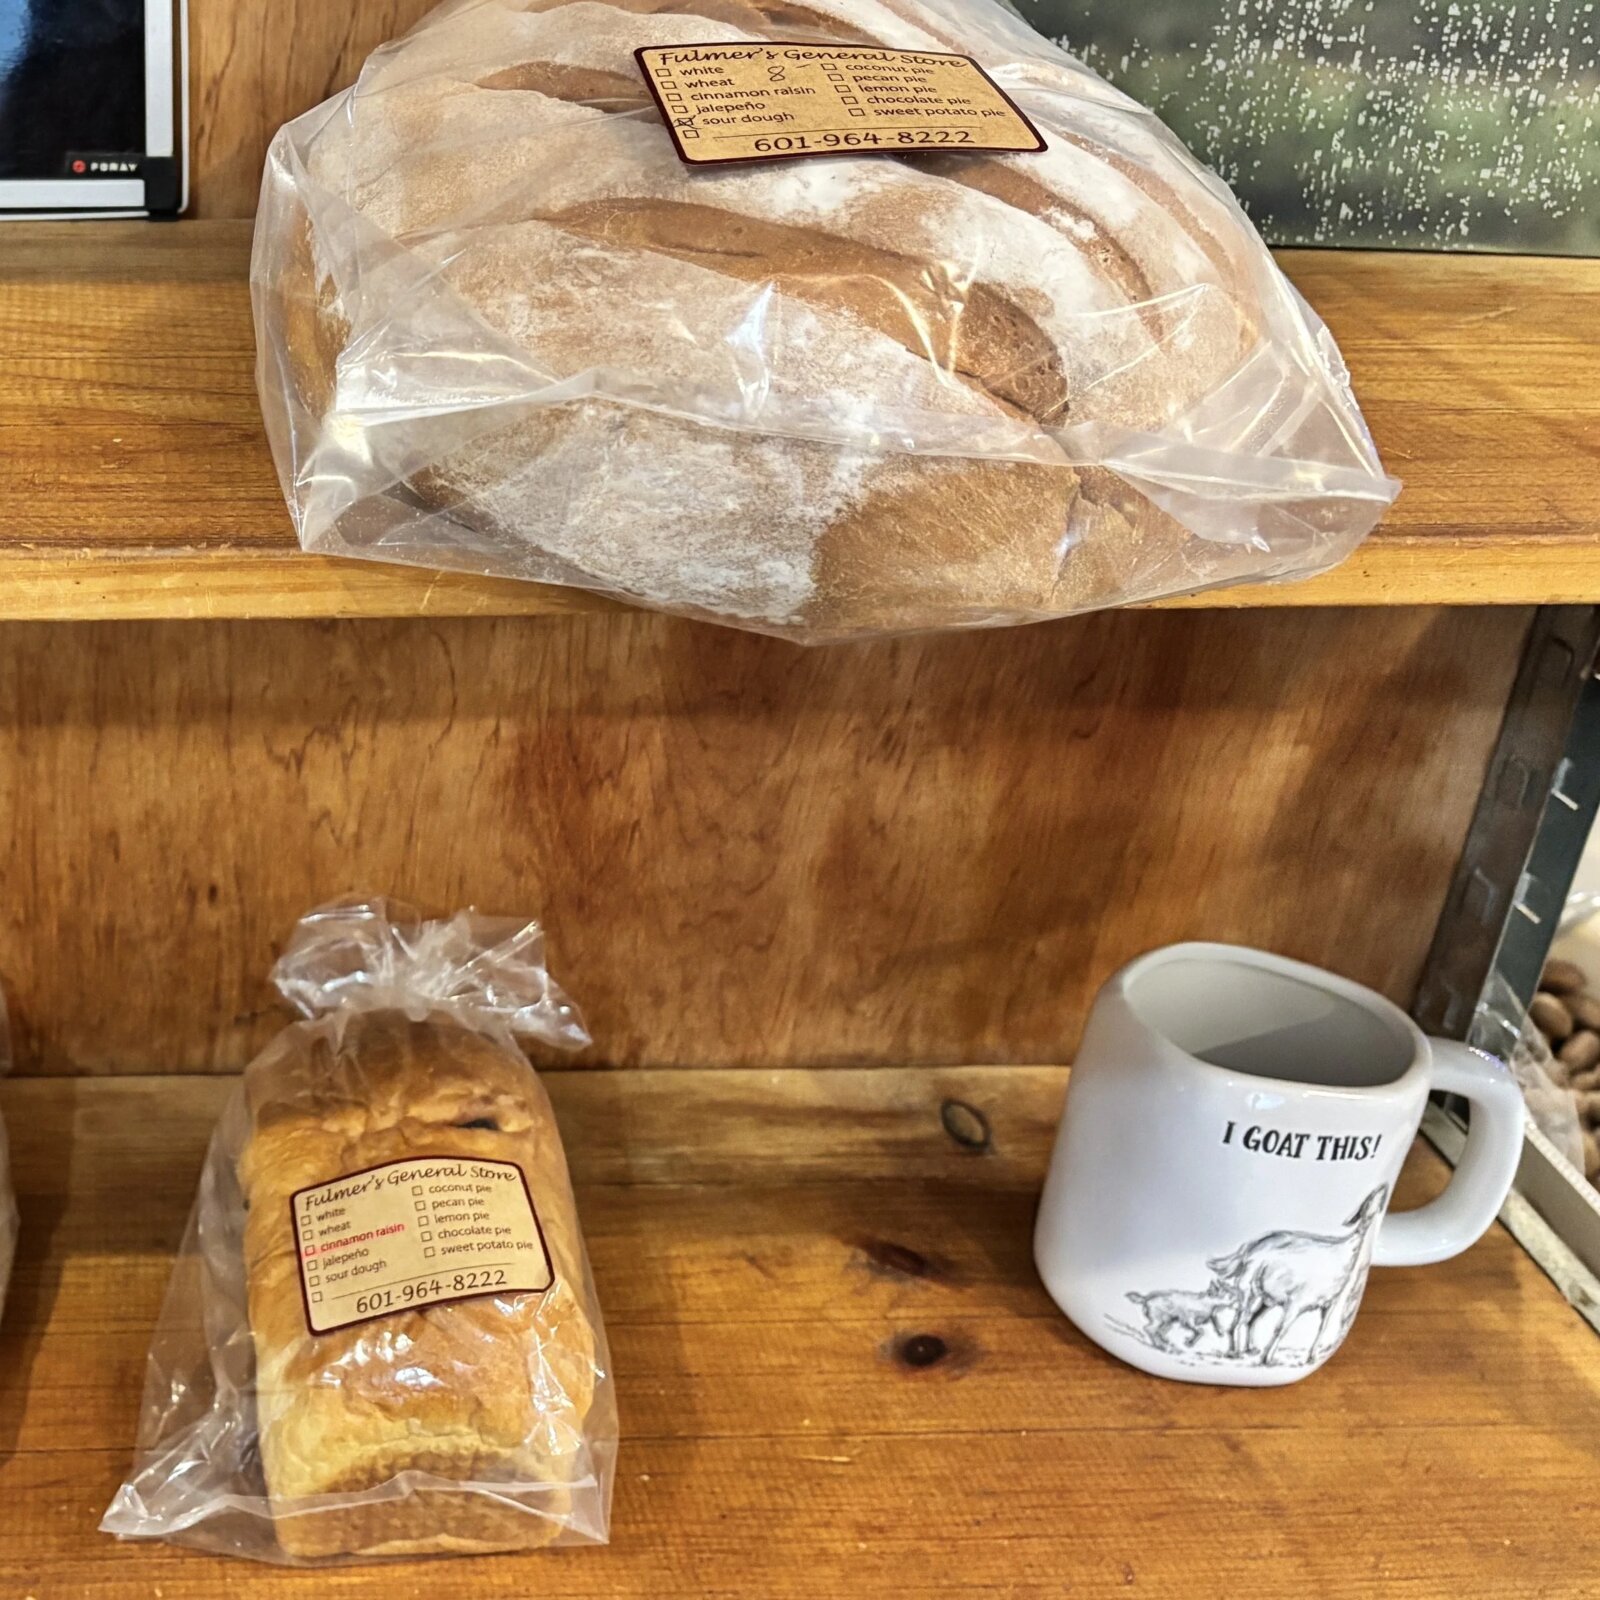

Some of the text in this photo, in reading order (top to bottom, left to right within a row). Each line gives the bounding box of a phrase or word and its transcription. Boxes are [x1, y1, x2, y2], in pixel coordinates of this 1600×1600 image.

[660, 48, 967, 68] Fulmer's General Store
[680, 65, 725, 76] white
[845, 62, 935, 75] coconut pie
[684, 77, 736, 89] wheat
[852, 73, 928, 84] pecan pie
[691, 86, 816, 101] cinnamon raisin
[858, 84, 938, 95] lemon pie
[695, 101, 766, 115] jalepeño
[866, 95, 972, 106] chocolate pie
[702, 111, 795, 126] sour dough
[873, 107, 1007, 118] sweet potato pie
[754, 130, 976, 152] 601-964-8222
[1222, 1120, 1382, 1160] I GOAT THIS!
[304, 1164, 517, 1211] Fulmer's General Store
[428, 1184, 493, 1194] coconut pie
[431, 1198, 486, 1211] pecan pie
[316, 1207, 346, 1222] white
[434, 1211, 491, 1224] lemon pie
[318, 1221, 351, 1236] wheat
[437, 1225, 513, 1239] chocolate pie
[320, 1222, 405, 1252] cinnamon raisin
[440, 1240, 535, 1255] sweet potato pie
[323, 1248, 370, 1270] jalepeño
[325, 1260, 388, 1283] sour dough
[356, 1269, 508, 1314] 601-964-8222
